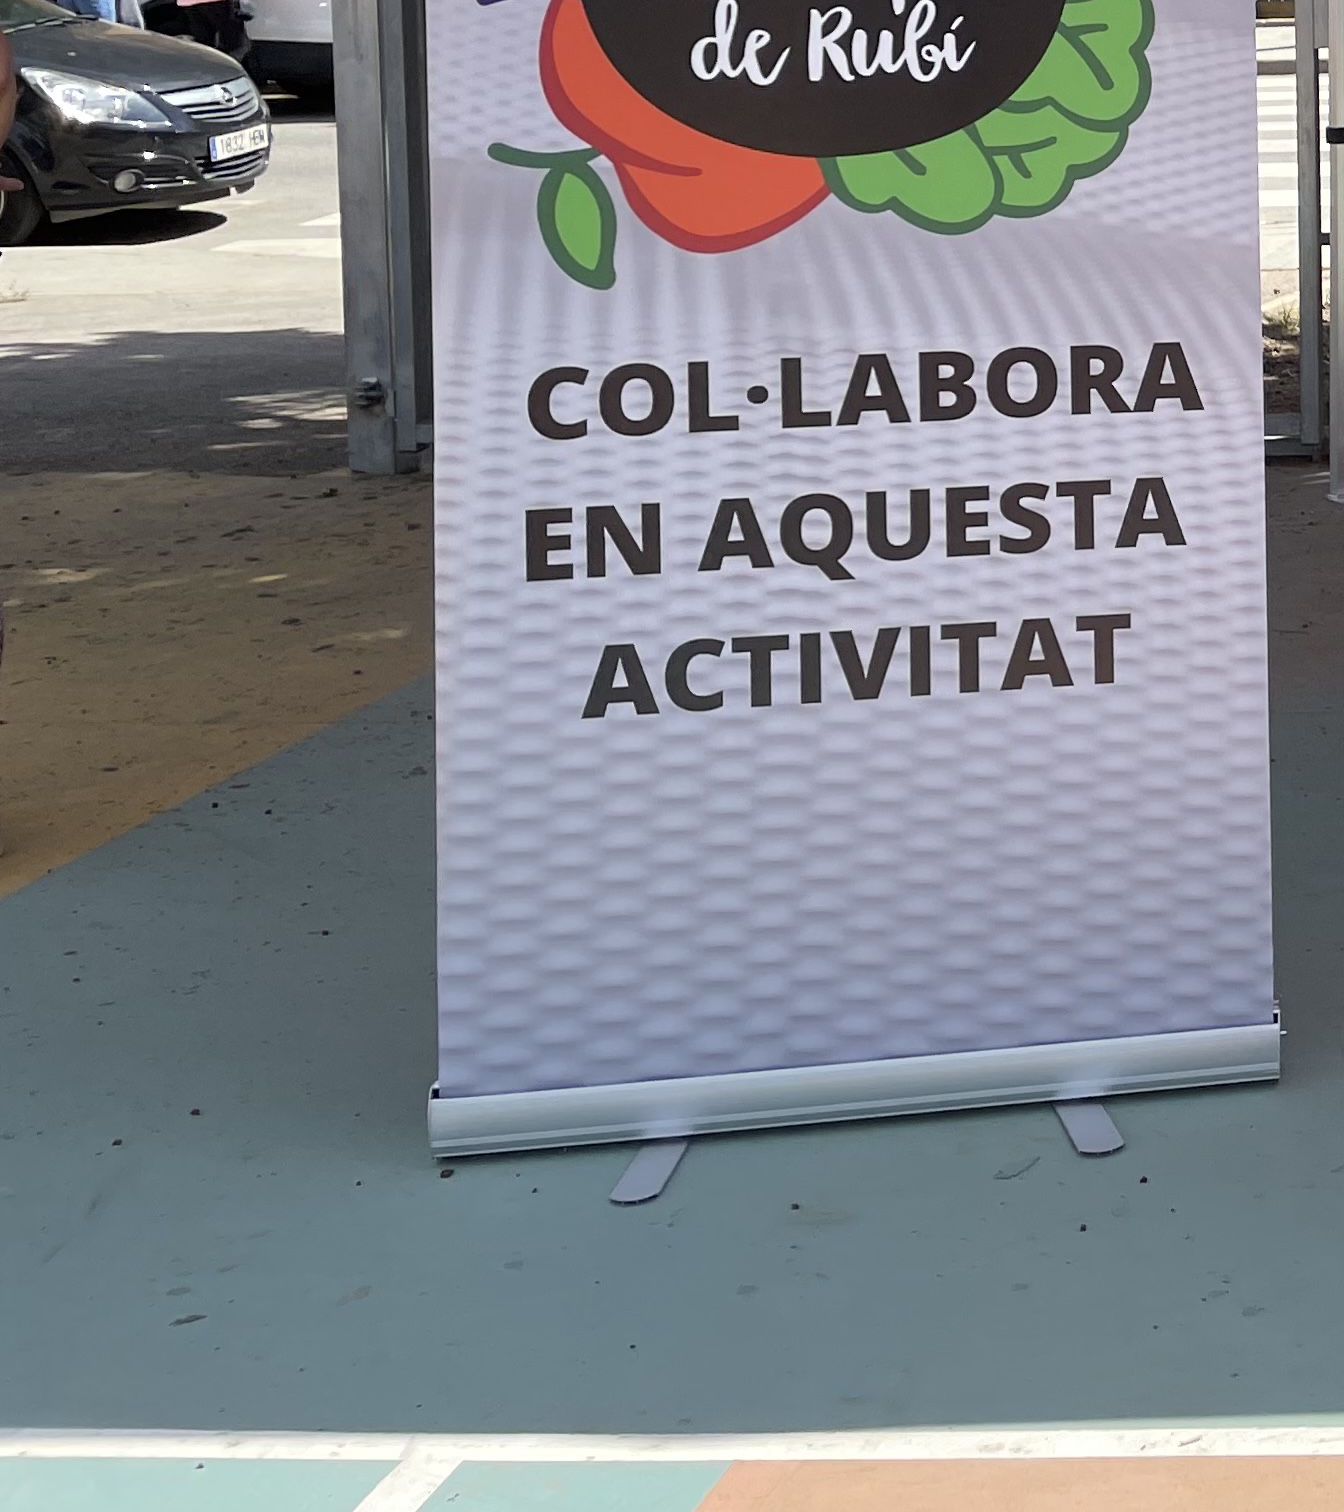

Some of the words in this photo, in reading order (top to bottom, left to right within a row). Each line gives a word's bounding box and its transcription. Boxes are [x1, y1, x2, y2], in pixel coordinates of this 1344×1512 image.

[807, 4, 977, 83] Rubí
[527, 341, 1205, 441] COL·LABORA
[524, 502, 662, 583] EN
[697, 476, 1187, 581] AQUESTA
[581, 613, 1132, 720] ACTIVITAT
